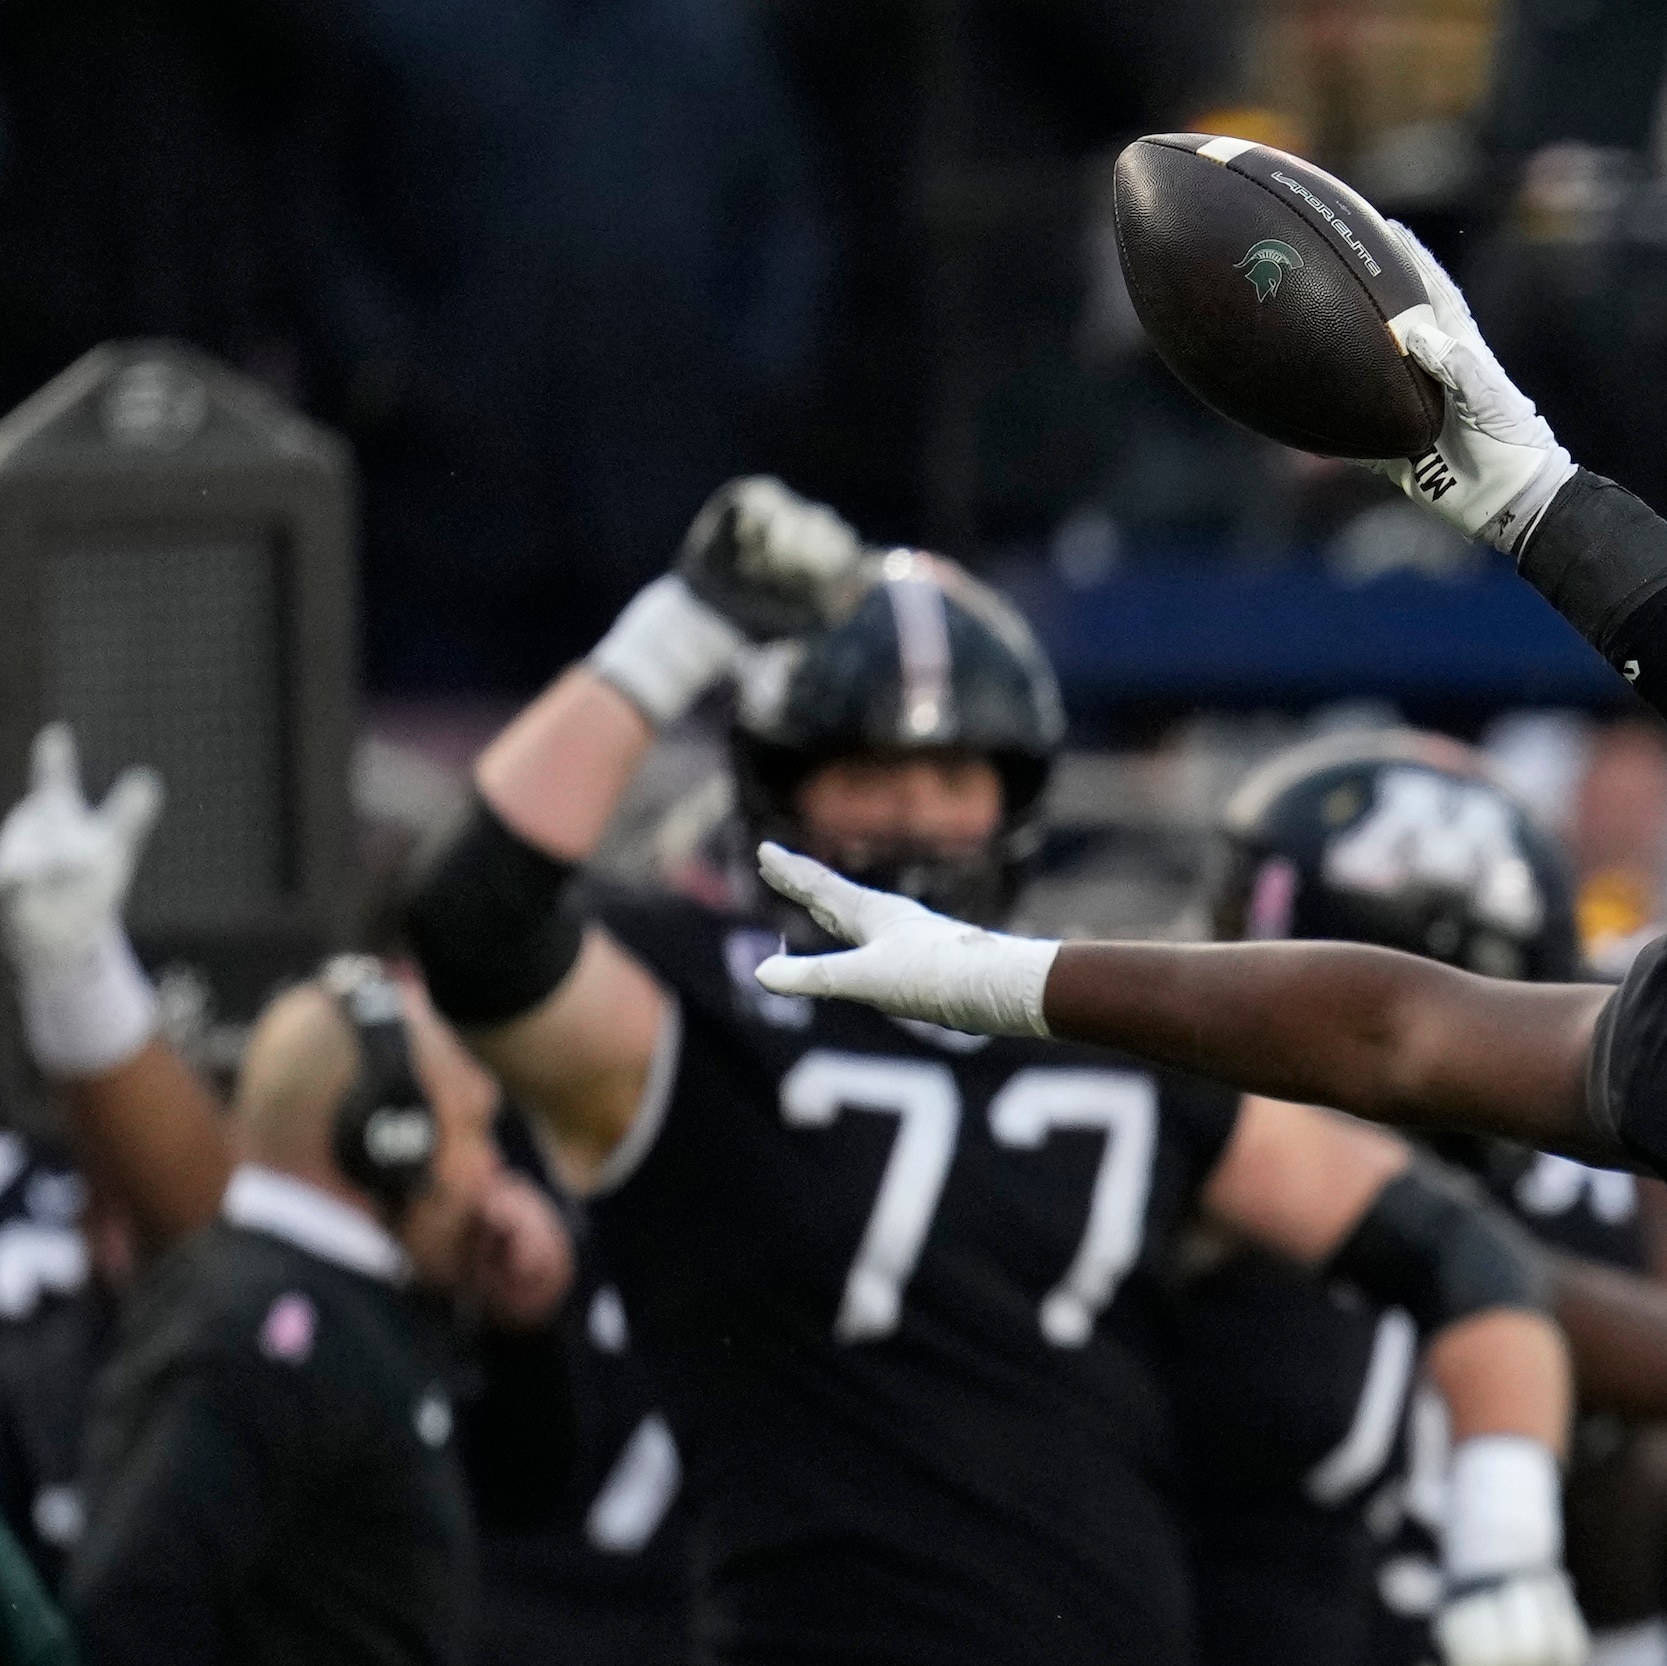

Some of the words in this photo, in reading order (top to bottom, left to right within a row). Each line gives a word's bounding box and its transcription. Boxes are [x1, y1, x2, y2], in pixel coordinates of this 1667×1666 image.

[1271, 169, 1335, 223] VAPOR
[1329, 216, 1382, 277] ELITE
[780, 1049, 1158, 1349] 77
